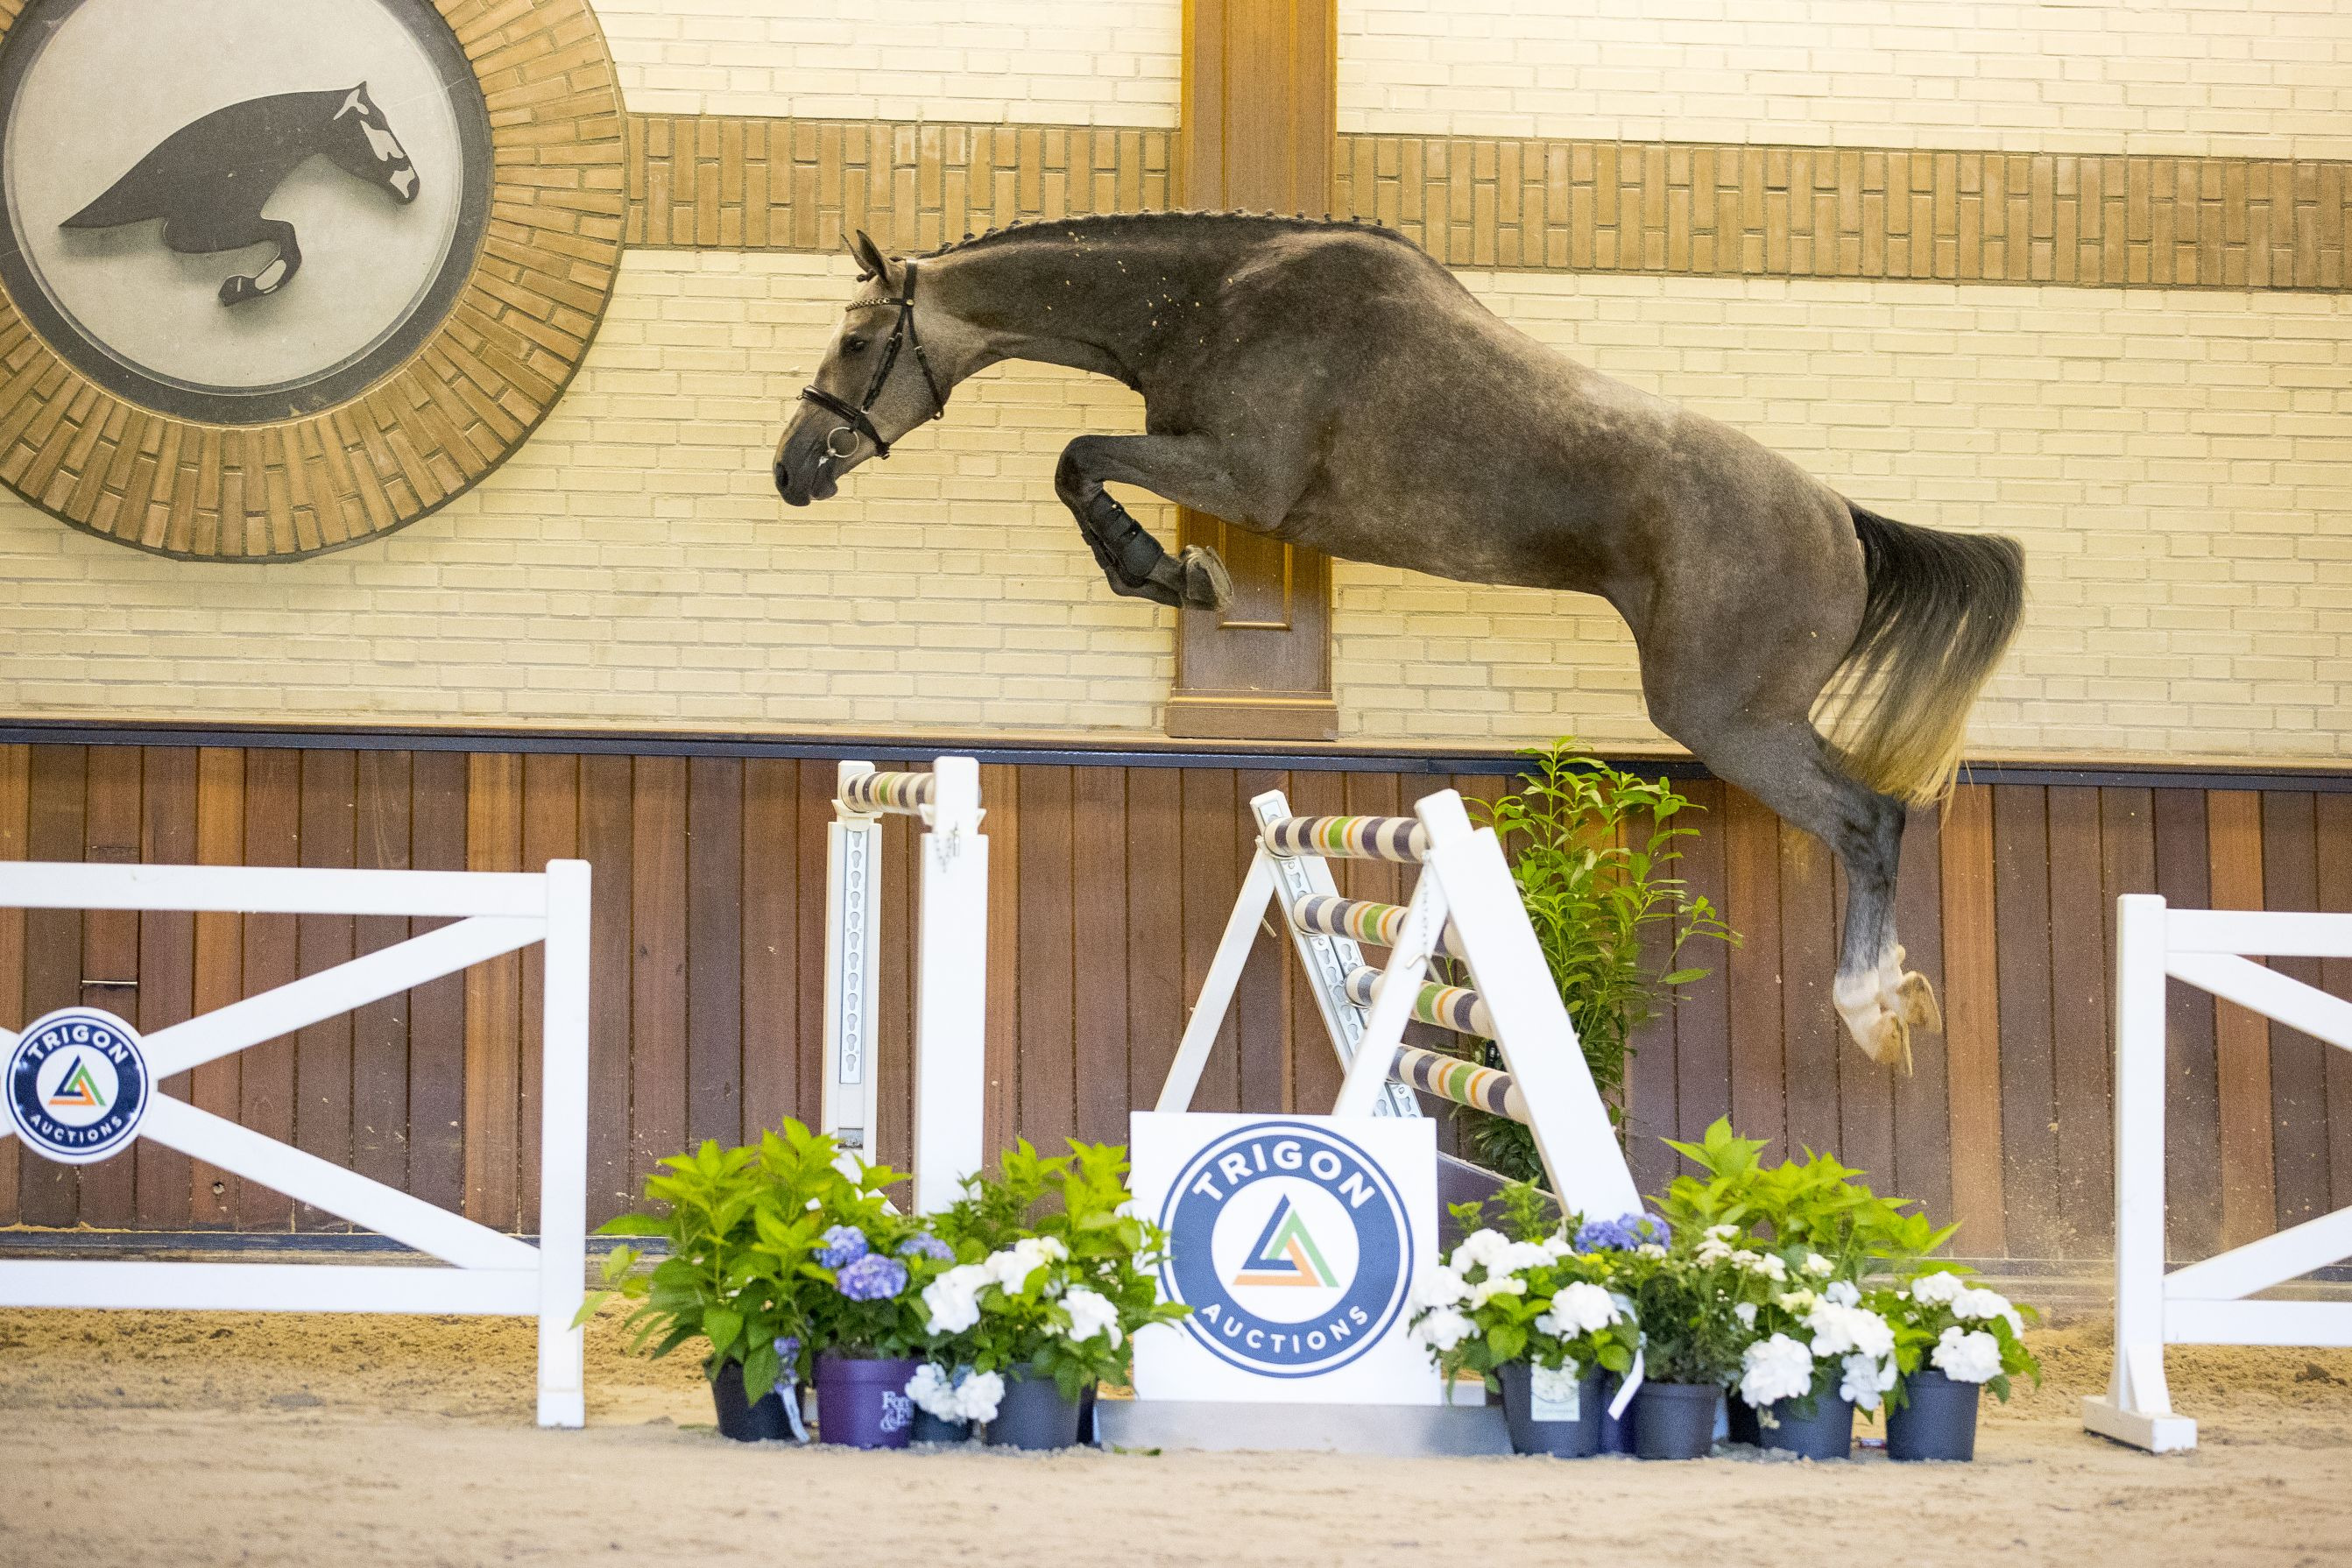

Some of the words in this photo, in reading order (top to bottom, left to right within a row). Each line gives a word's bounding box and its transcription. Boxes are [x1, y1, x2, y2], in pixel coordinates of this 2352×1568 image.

[28, 1025, 129, 1064] TRIGON
[30, 1114, 123, 1143] AUCTIONS
[1192, 1141, 1375, 1209] TRIGON
[1202, 1303, 1368, 1354] AUCTIONS
